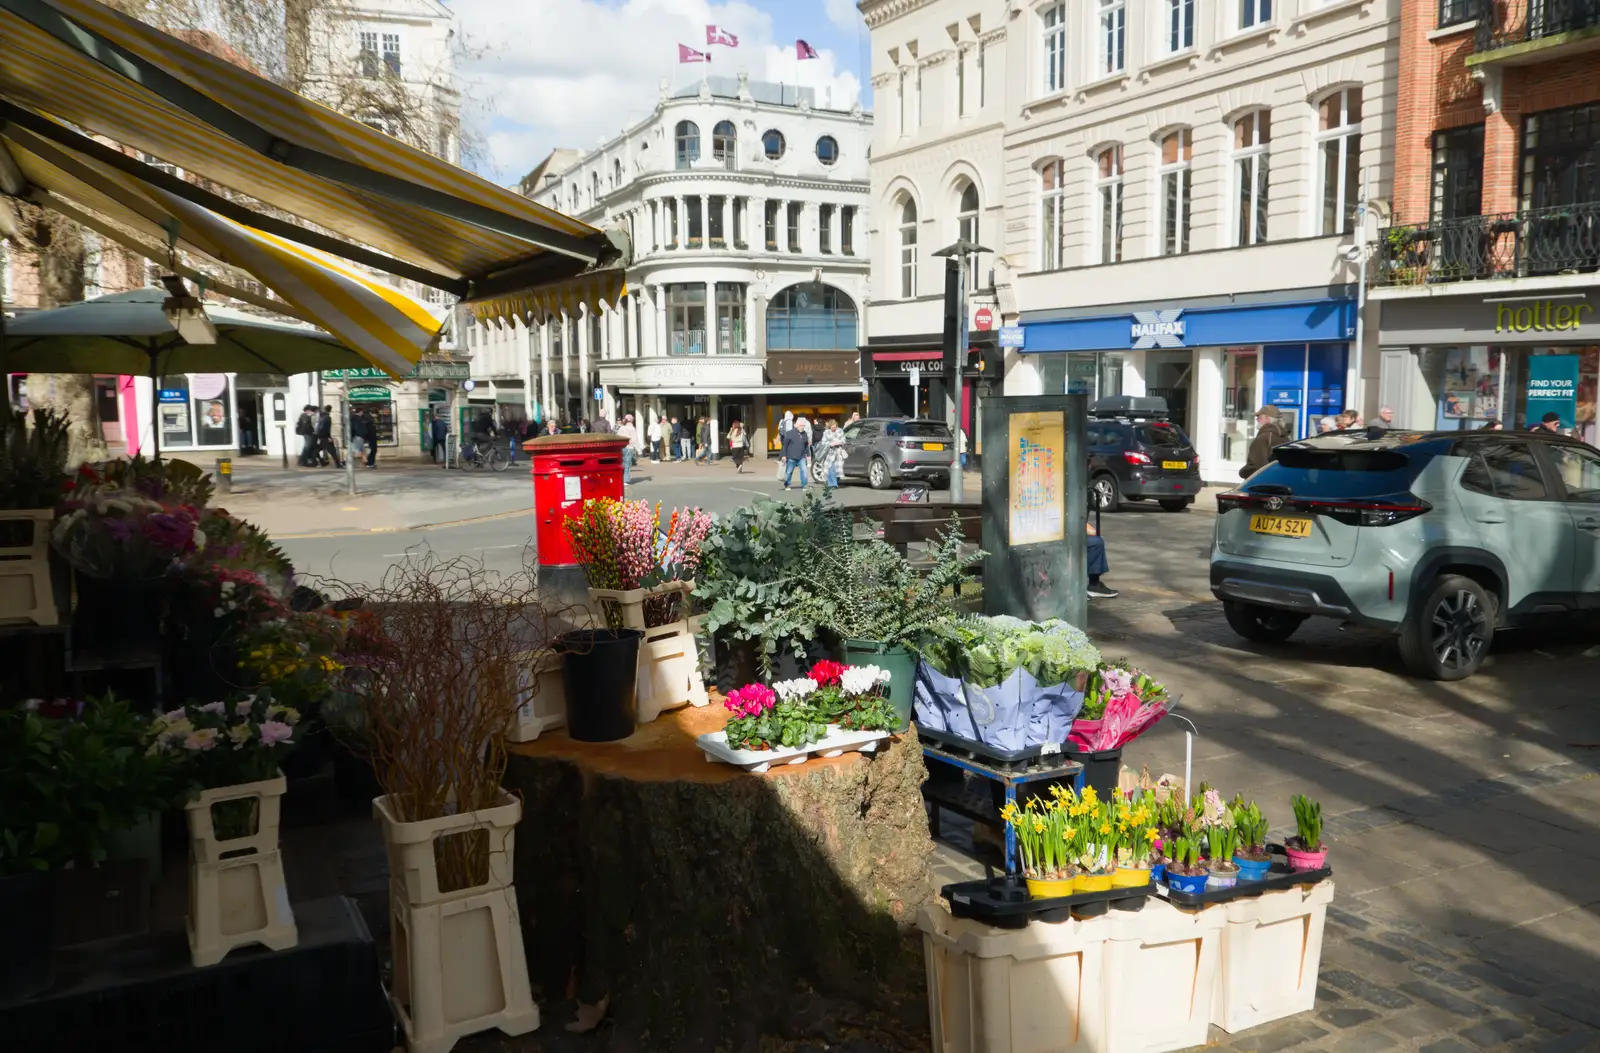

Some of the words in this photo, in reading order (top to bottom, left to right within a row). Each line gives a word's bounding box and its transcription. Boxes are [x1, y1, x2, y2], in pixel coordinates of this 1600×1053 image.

[1496, 300, 1593, 331] hotter
[1131, 321, 1185, 337] HALIFAX
[1528, 389, 1561, 397] PERFECT
[1562, 389, 1574, 397] FIT
[1256, 516, 1282, 531] AU74
[1285, 520, 1307, 534] SZV
